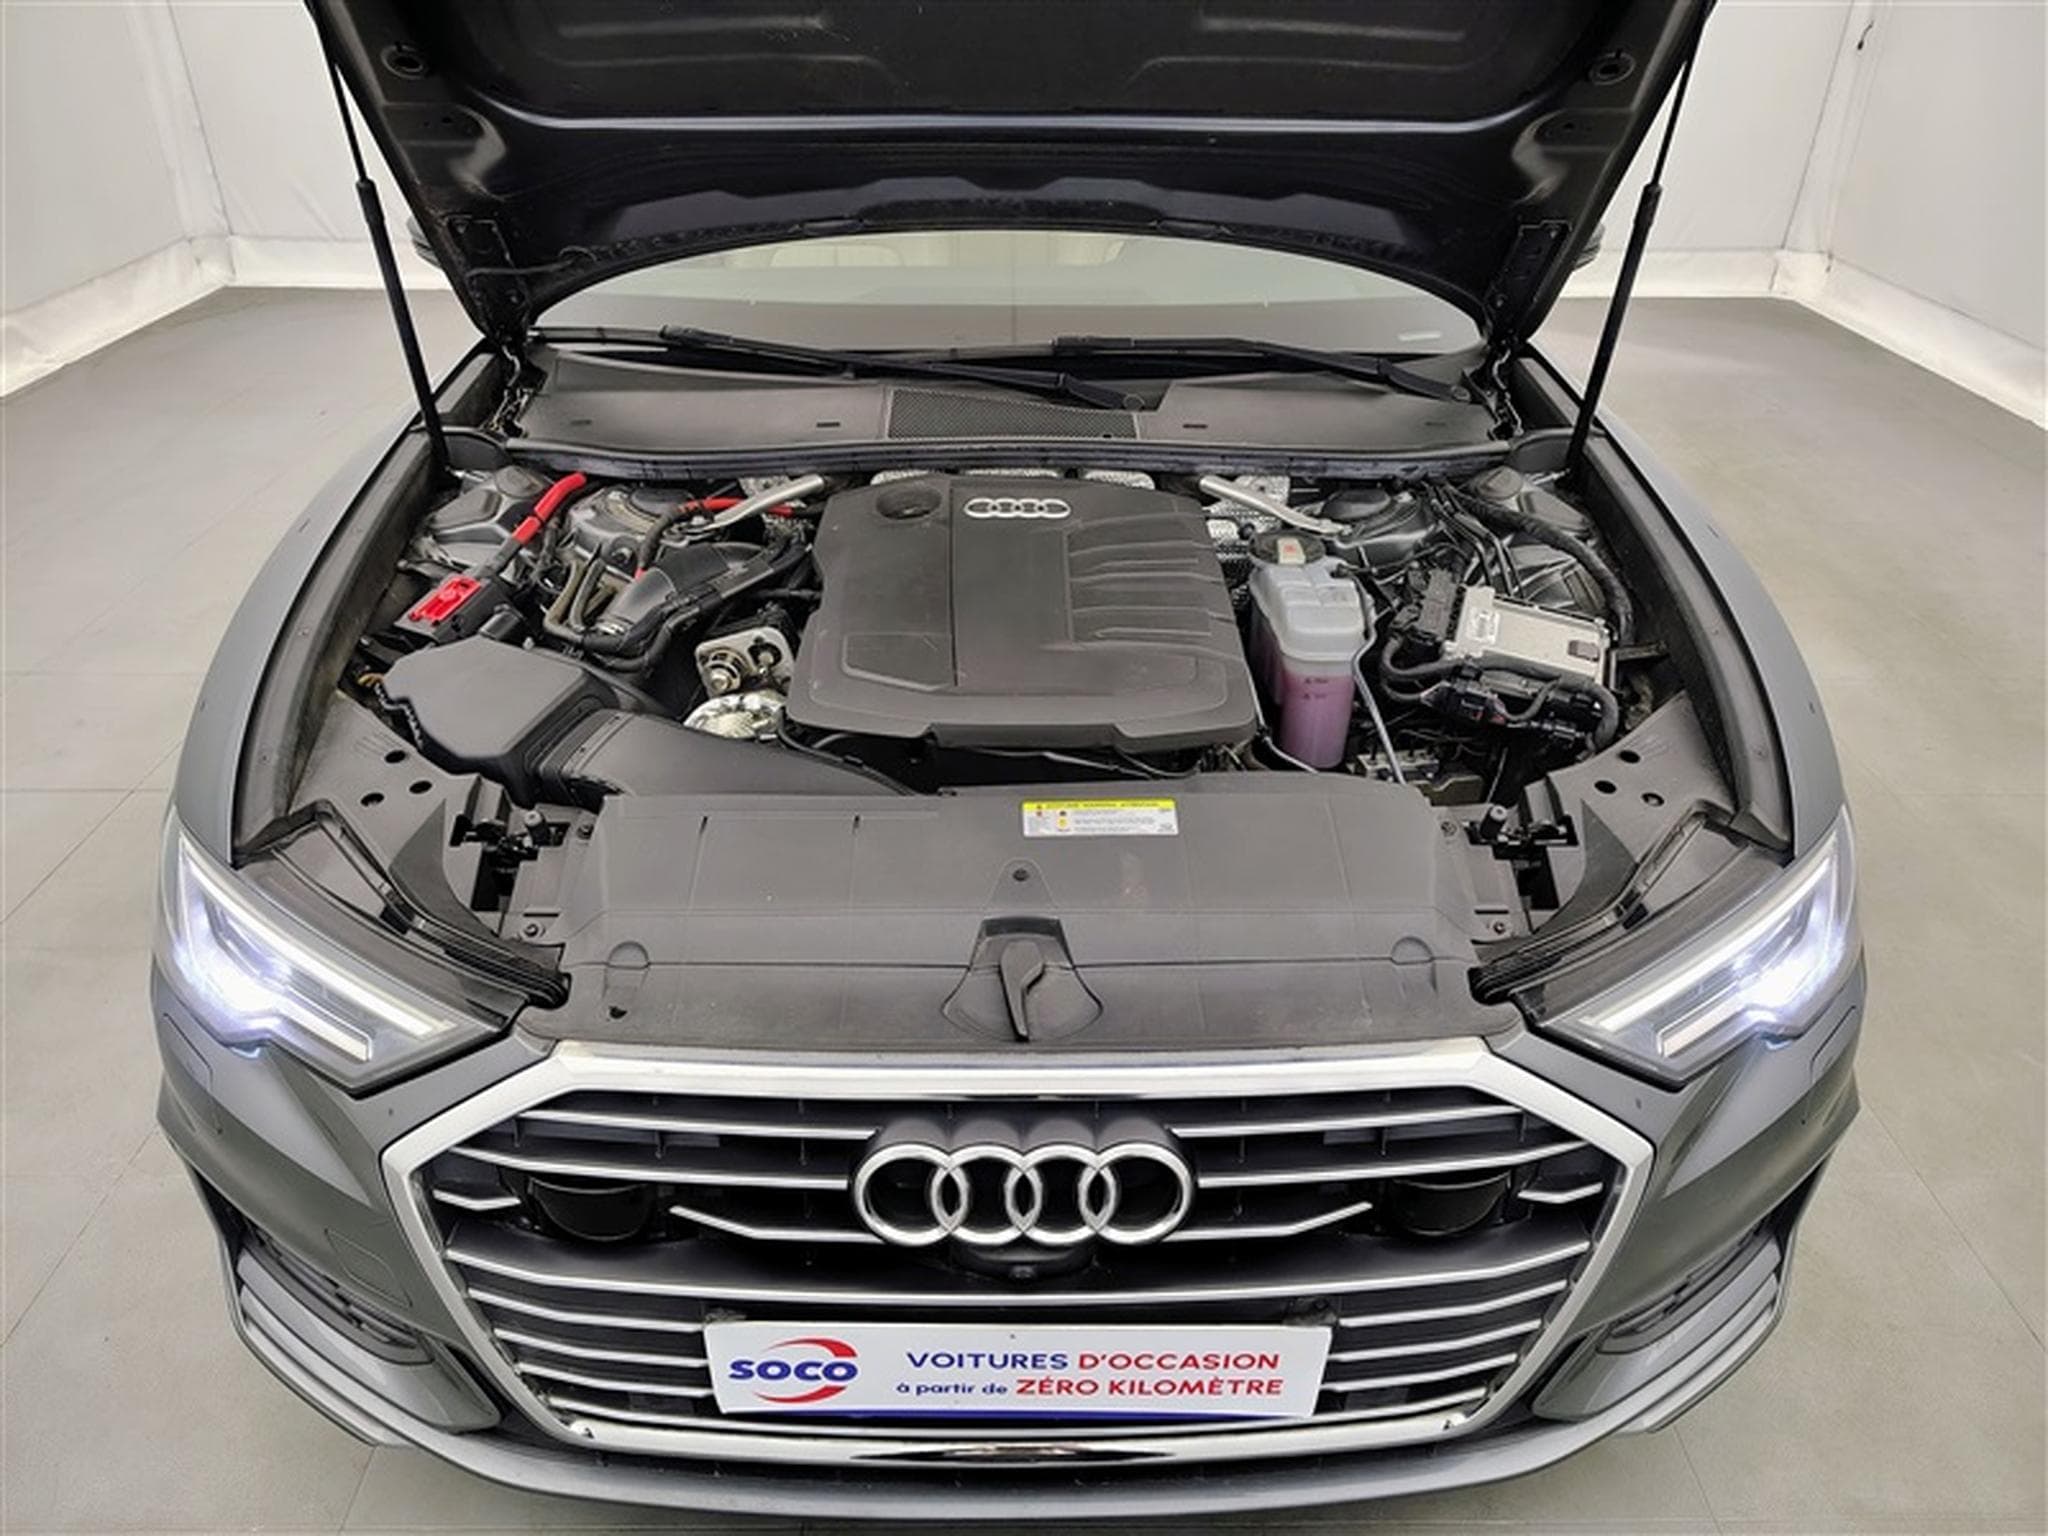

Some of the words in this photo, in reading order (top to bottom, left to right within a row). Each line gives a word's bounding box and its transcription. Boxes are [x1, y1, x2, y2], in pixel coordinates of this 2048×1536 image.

[729, 1359, 858, 1381] SOCO
[906, 1352, 1068, 1370] VOITURES
[1078, 1353, 1280, 1370] D'OCCASION
[917, 1382, 975, 1396] partir
[981, 1382, 1008, 1394] de
[1016, 1376, 1099, 1395] ZÉRO
[1108, 1376, 1284, 1395] KILOMÈTRE
